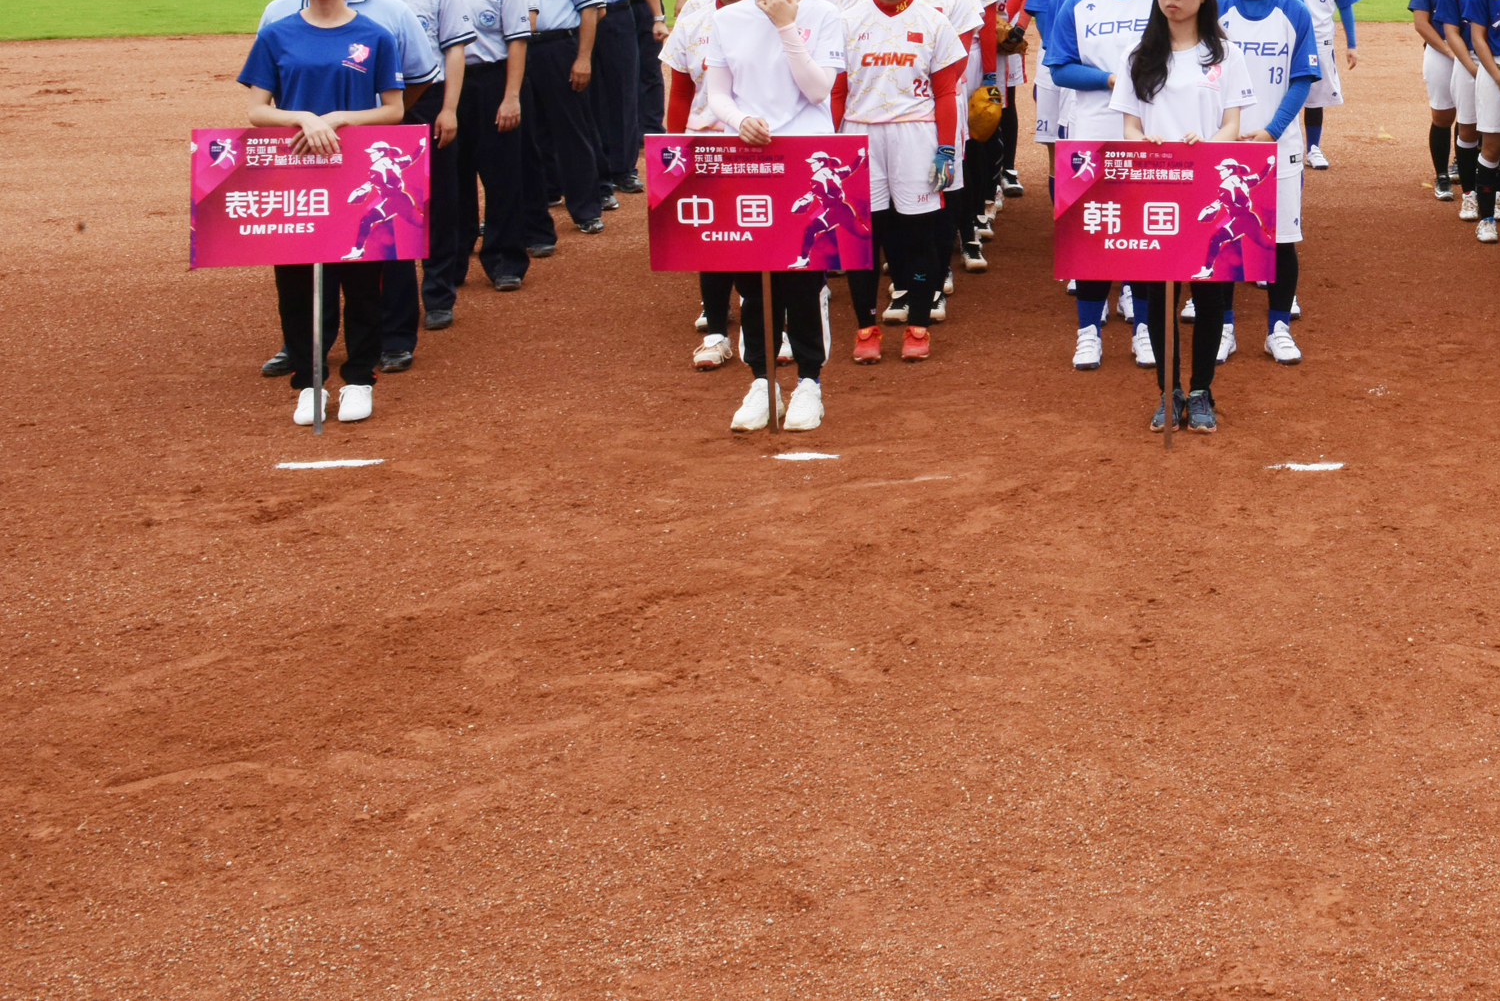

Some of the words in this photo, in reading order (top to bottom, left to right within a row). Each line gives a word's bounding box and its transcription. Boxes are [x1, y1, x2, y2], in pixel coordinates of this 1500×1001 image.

[1085, 19, 1150, 39] KORE
[860, 51, 918, 68] CHINA
[1268, 67, 1284, 85] 13
[912, 79, 930, 98] 22
[1036, 119, 1048, 132] 21
[695, 163, 785, 174] 女子垒球锦标赛
[1104, 159, 1132, 167] 东亚杯
[1104, 169, 1194, 181] 女子垒球锦标赛
[225, 189, 330, 219] 裁判组
[677, 195, 773, 227] 中国
[1083, 201, 1180, 235] 韩国
[239, 223, 315, 235] UMPIRES
[701, 231, 753, 242] CHINA
[1104, 239, 1161, 249] KOREA
